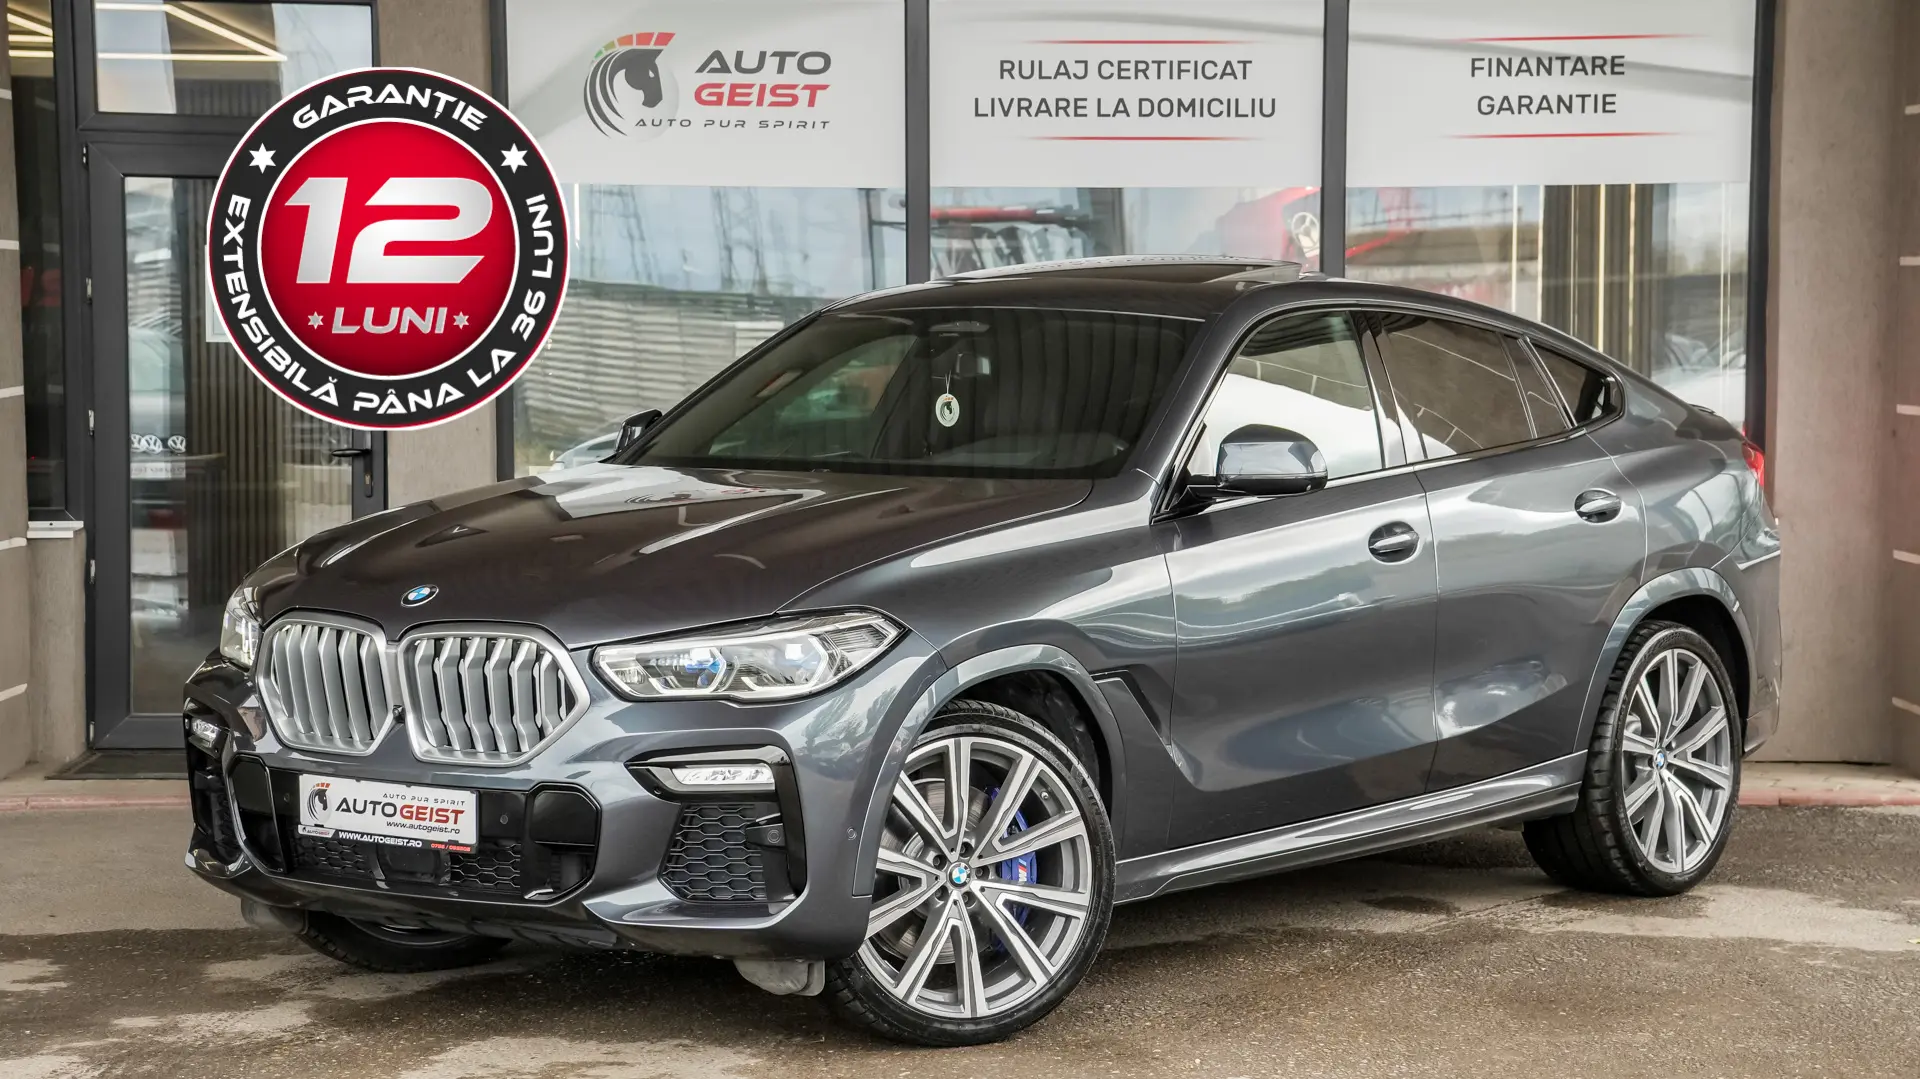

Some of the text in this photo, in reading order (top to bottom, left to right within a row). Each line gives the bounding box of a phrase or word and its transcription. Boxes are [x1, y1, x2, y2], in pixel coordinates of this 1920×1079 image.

[694, 49, 832, 76] AUTO
[999, 59, 1253, 81] RULAJ CERTIFICAT
[1470, 55, 1626, 78] FINANTARE
[693, 82, 832, 108] GEIST
[1477, 93, 1617, 116] GARANTIE
[974, 97, 1277, 118] LIVRARE LA DOMICILIU
[634, 118, 831, 130] AUTO PUR SPIRIT
[382, 792, 466, 807] AUTO PUR SPIRIT
[386, 820, 461, 835] www.autogeist.ro
[338, 830, 423, 848] WWW.AUTOGEIST.RO
